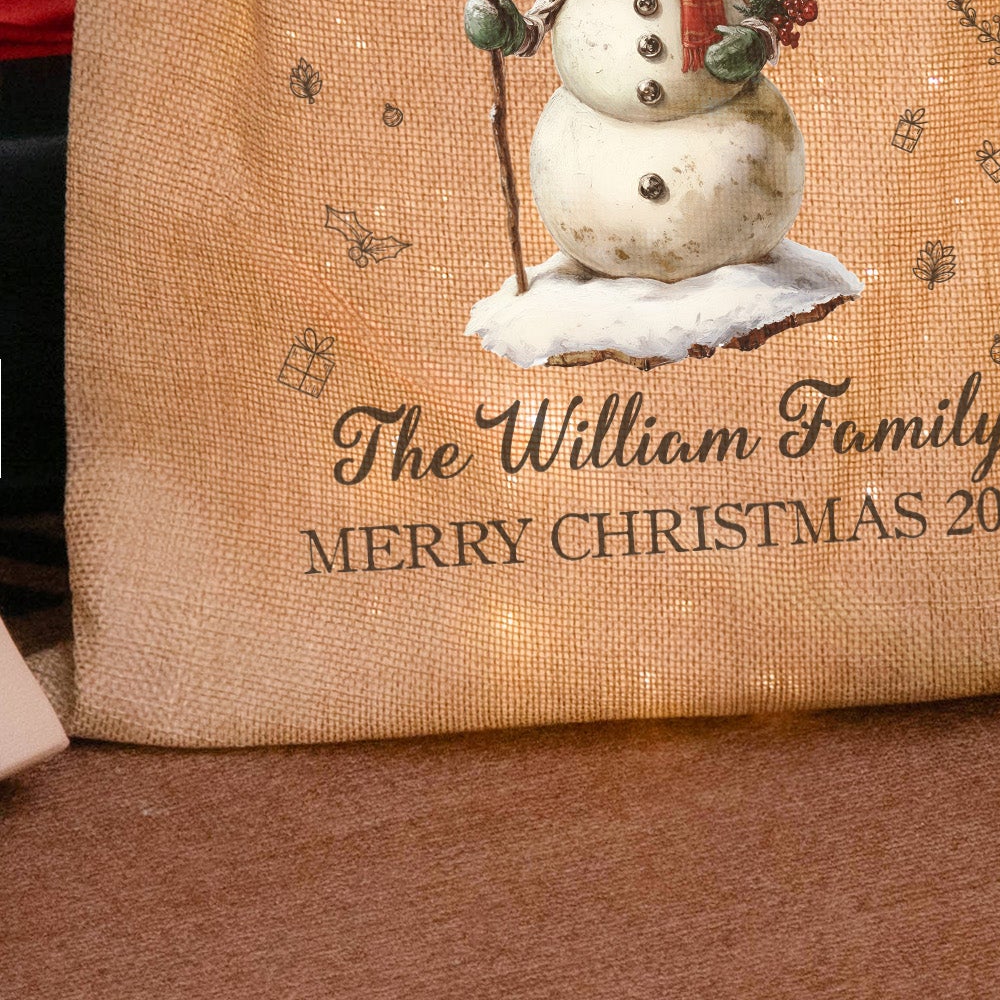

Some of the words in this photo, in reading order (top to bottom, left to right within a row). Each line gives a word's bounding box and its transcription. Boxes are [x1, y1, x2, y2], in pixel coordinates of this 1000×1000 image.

[332, 403, 474, 486] The
[475, 391, 761, 474] William
[300, 517, 532, 576] MERRY
[550, 491, 928, 562] CHRISTMAS
